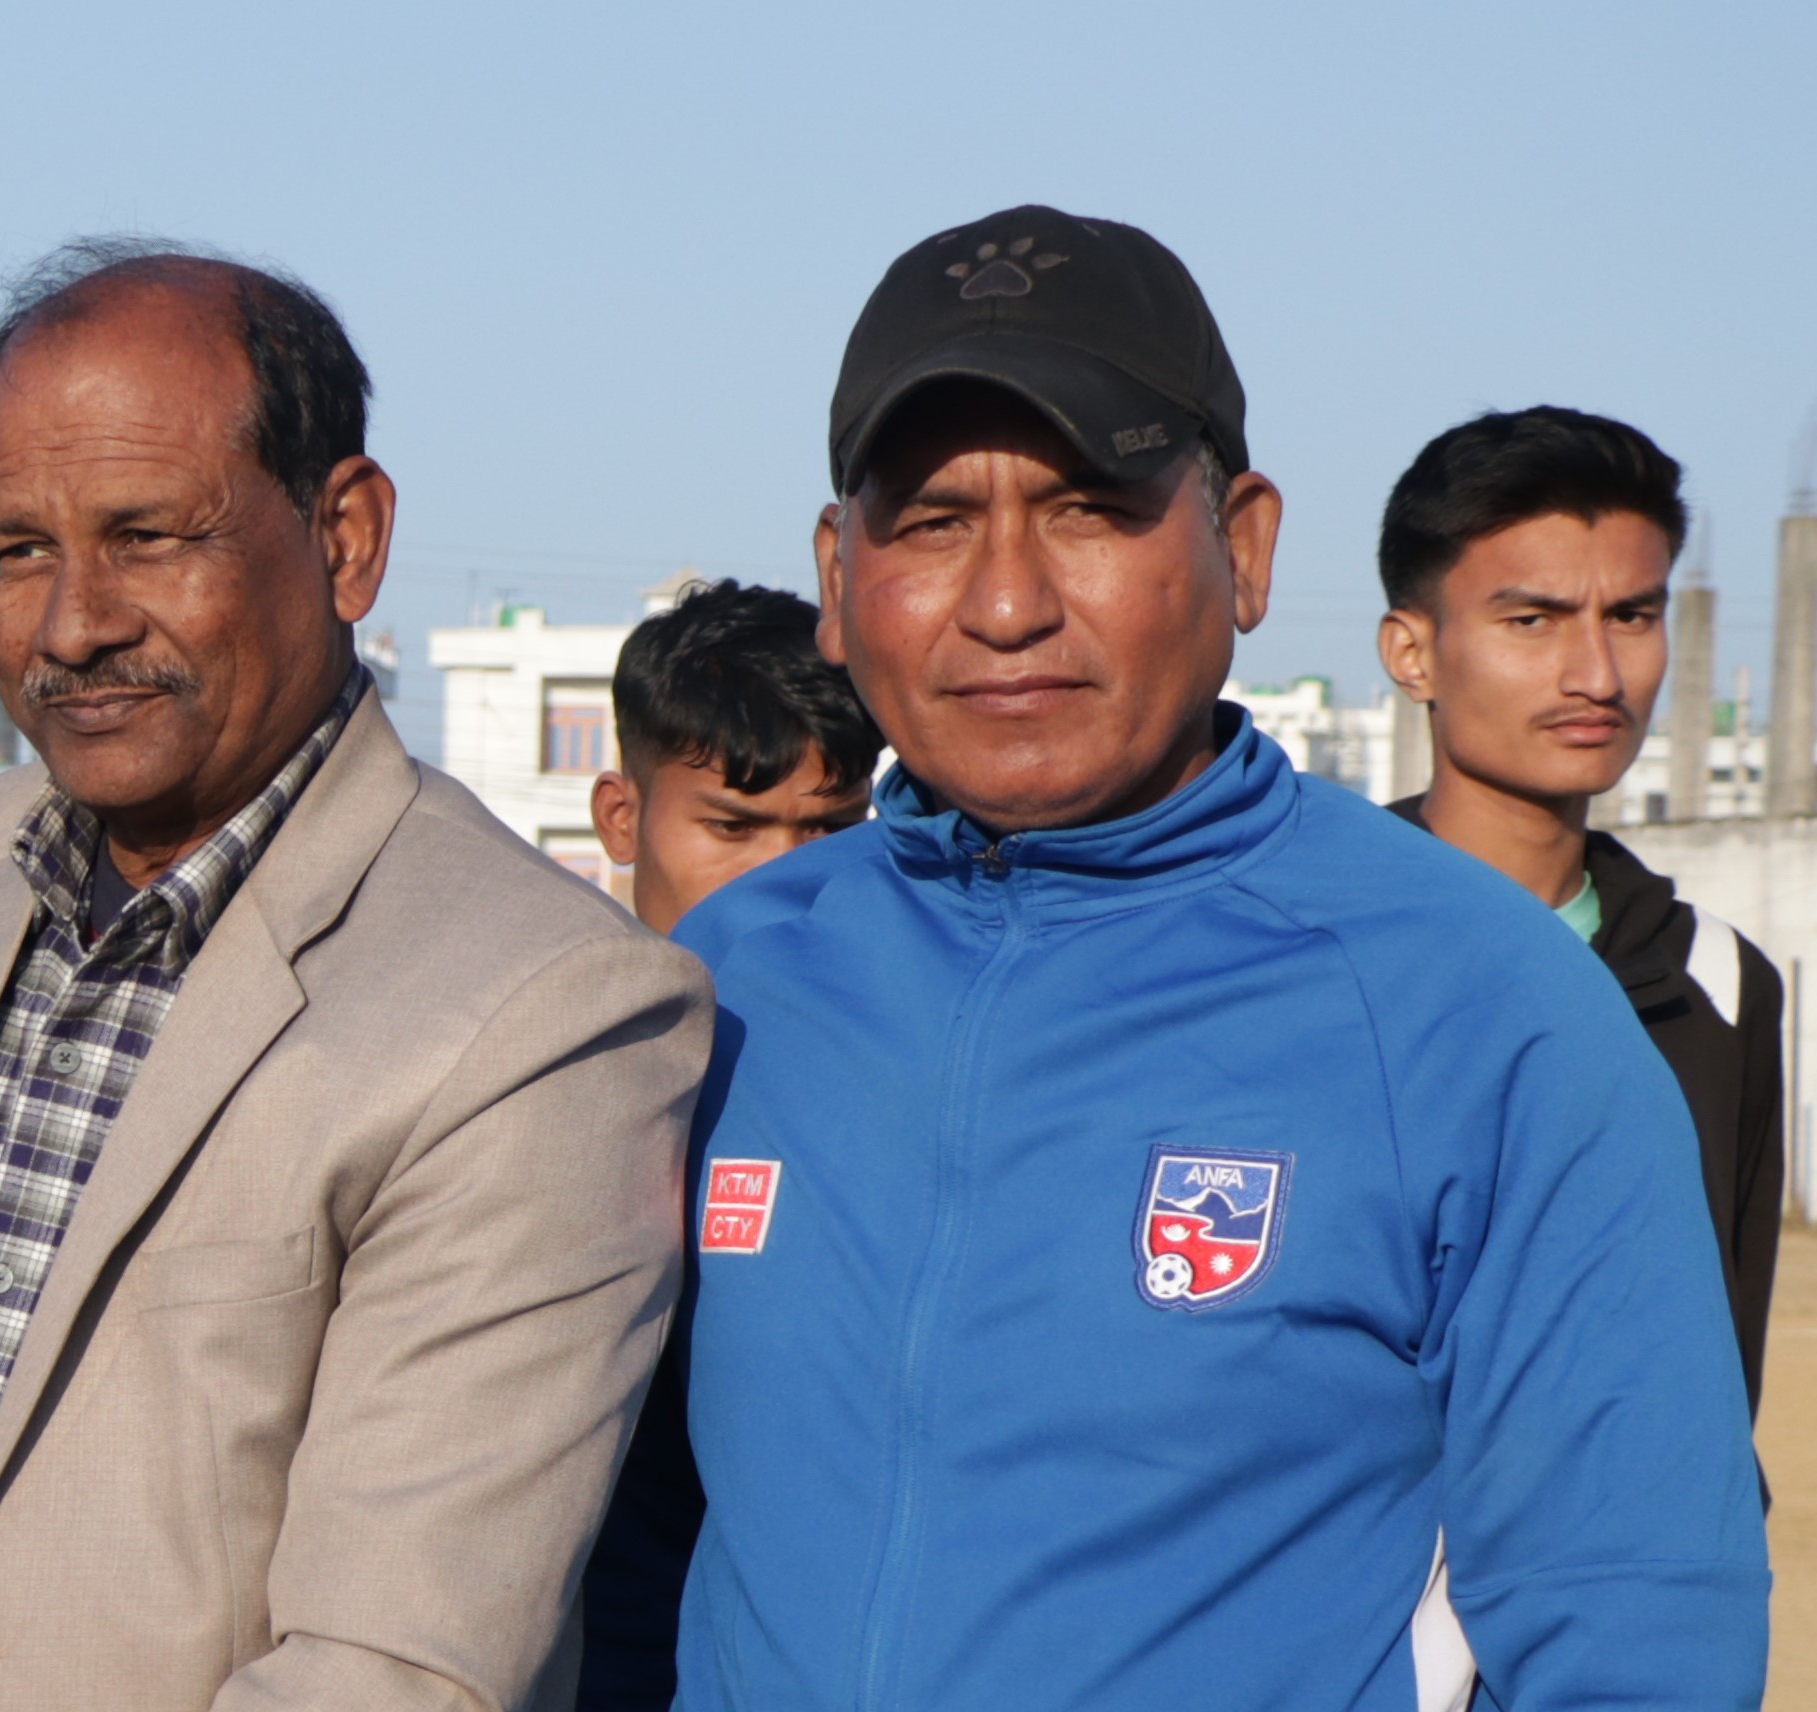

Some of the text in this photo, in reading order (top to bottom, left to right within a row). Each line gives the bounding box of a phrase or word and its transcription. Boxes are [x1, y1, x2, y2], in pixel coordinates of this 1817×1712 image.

[717, 1172, 765, 1197] KTM
[1183, 1164, 1246, 1190] ANFA
[710, 1215, 755, 1240] CTY
